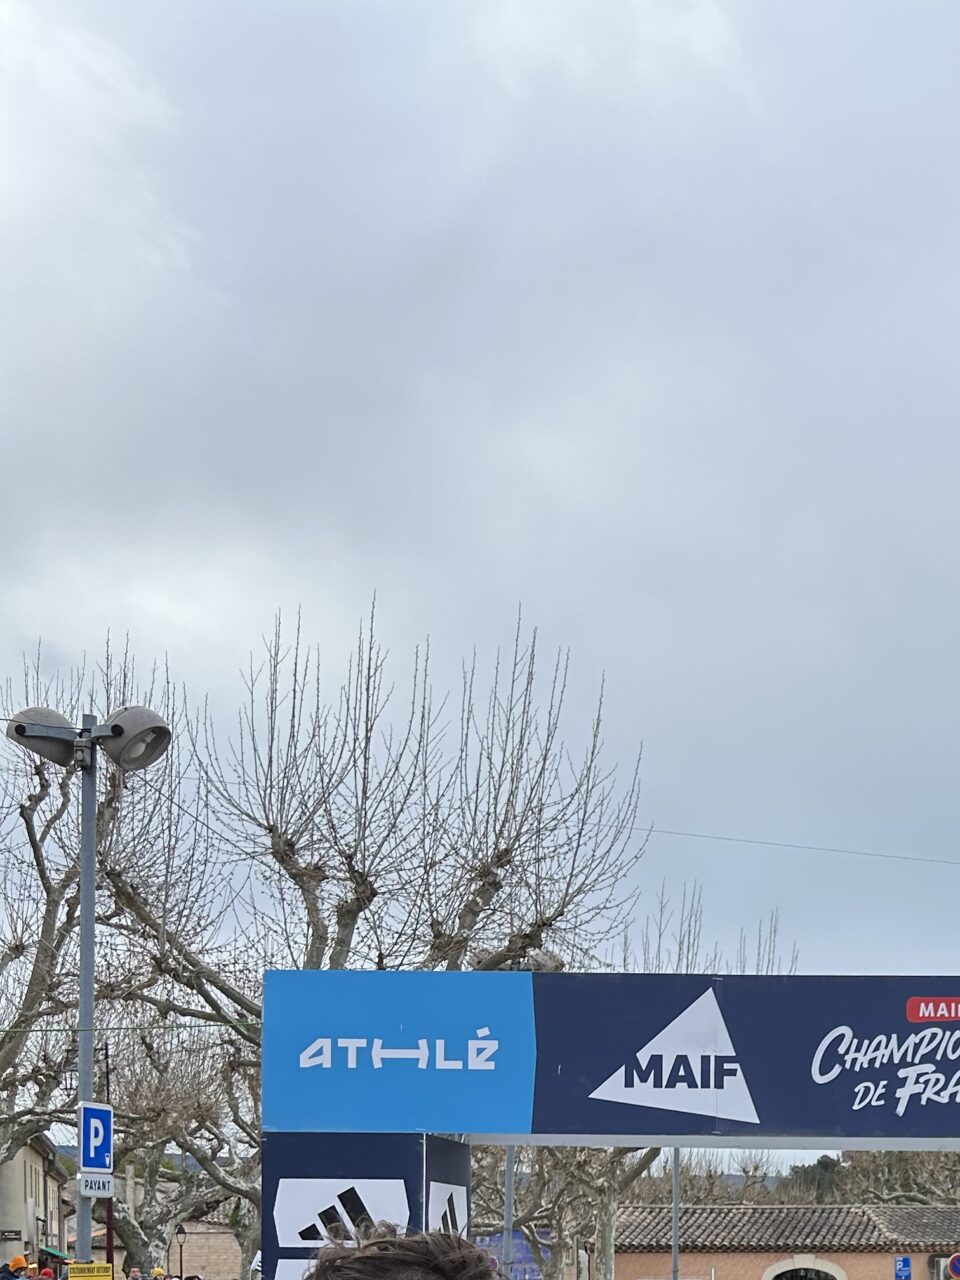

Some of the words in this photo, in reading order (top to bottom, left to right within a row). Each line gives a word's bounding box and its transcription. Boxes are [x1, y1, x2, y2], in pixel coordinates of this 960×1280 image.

[299, 1026, 499, 1070] ATHLÉ
[623, 1054, 740, 1089] MAIF
[852, 1080, 888, 1111] DE
[89, 1118, 105, 1158] P
[84, 1179, 111, 1192] PAYANT
